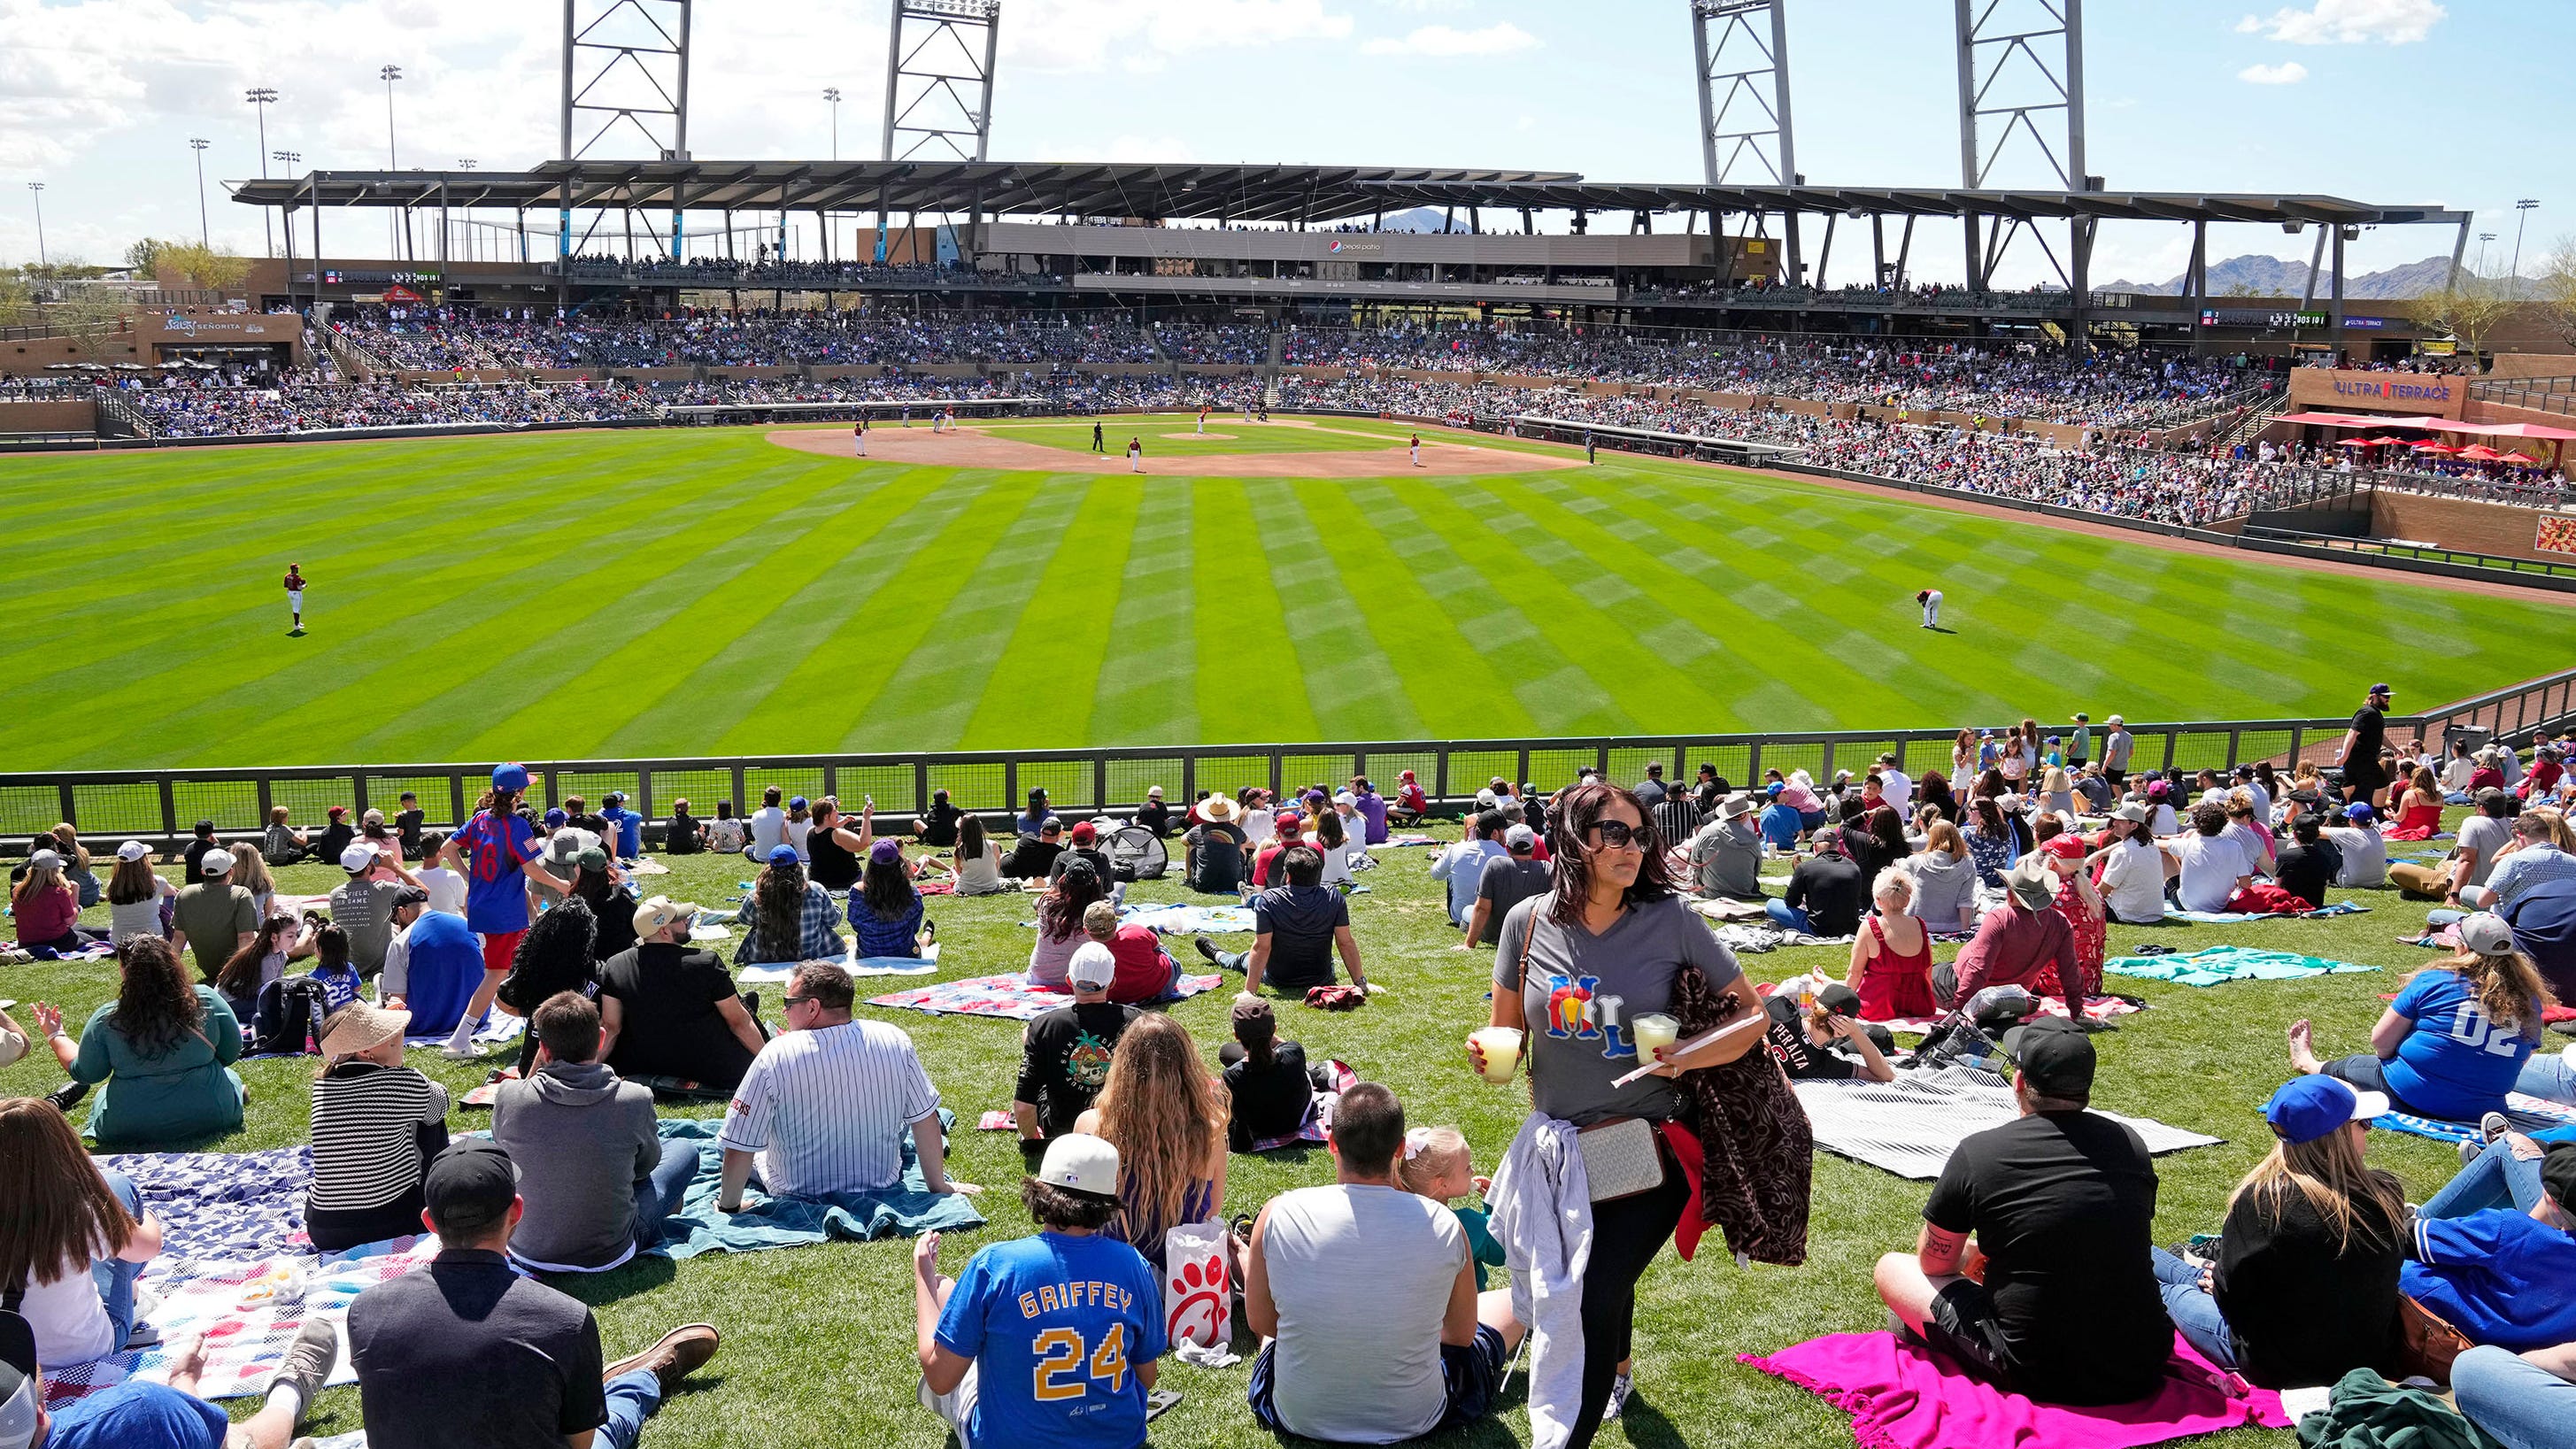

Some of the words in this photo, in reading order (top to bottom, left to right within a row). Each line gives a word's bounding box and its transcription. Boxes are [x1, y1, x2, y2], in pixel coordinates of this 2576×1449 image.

[197, 321, 241, 330] SEÑORITA
[2335, 382, 2382, 397] ULTRA
[2391, 384, 2449, 400] TERRACE
[327, 983, 352, 1007] 22
[1772, 1022, 1809, 1070] PERALTA
[1018, 1281, 1132, 1320] GRIFFEY
[1032, 1322, 1128, 1402] 24
